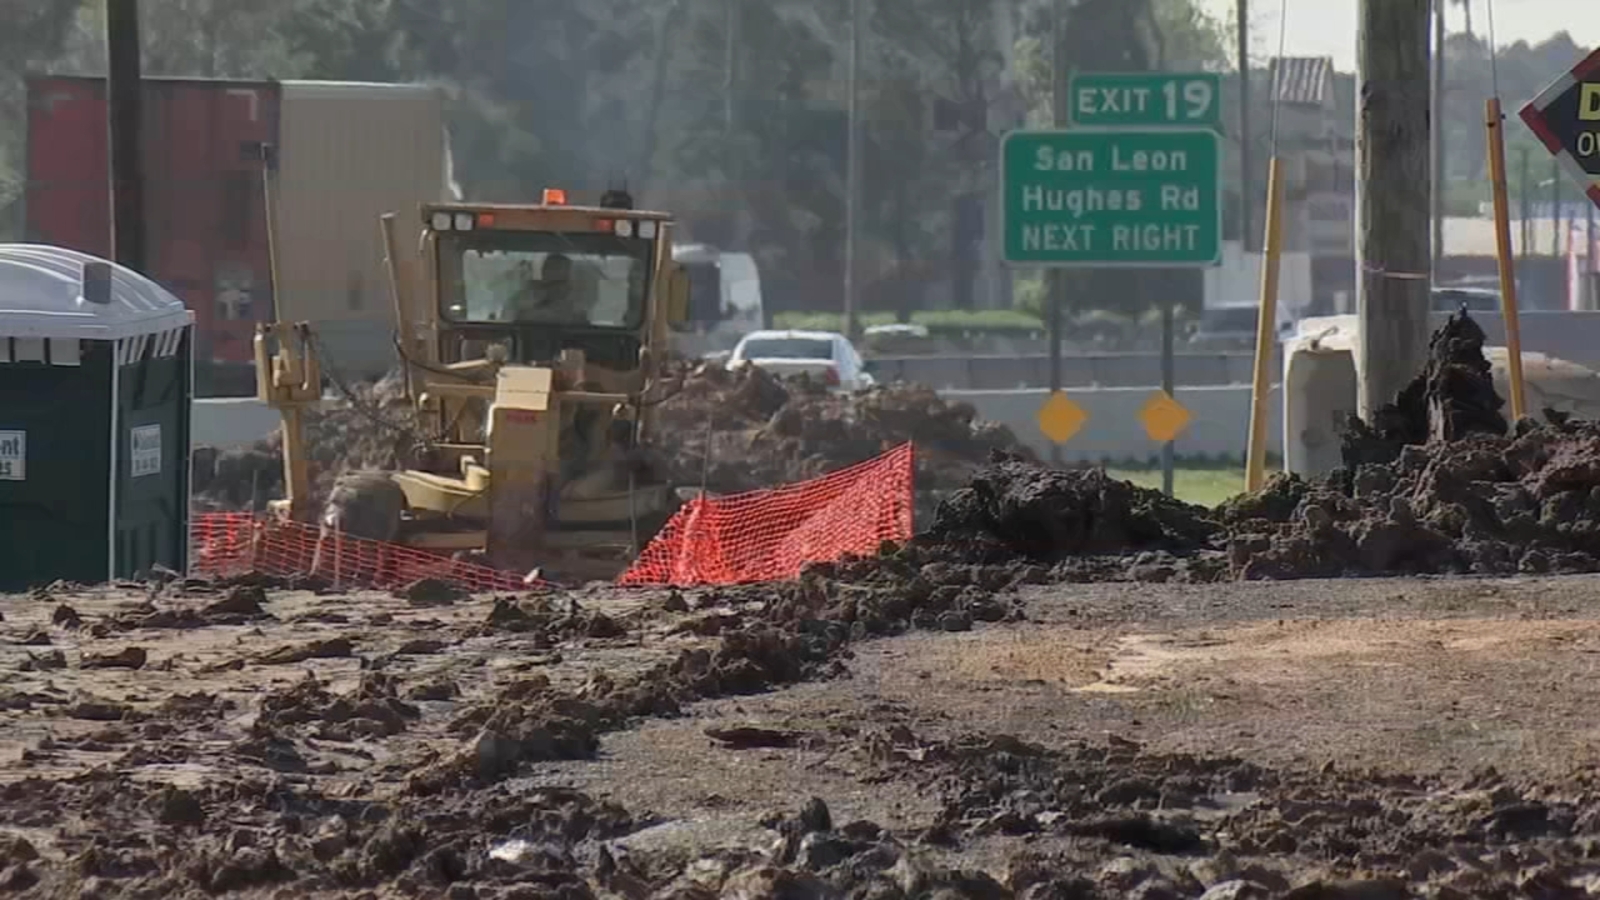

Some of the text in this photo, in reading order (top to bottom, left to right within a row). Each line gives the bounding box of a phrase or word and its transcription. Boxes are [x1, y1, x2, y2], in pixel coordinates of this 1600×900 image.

[1078, 80, 1212, 119] EXIT 19
[1577, 131, 1600, 156] O
[1034, 145, 1186, 171] San Leon
[1022, 185, 1199, 218] Hughes Rd
[1022, 224, 1199, 251] NEXT RIGHT
